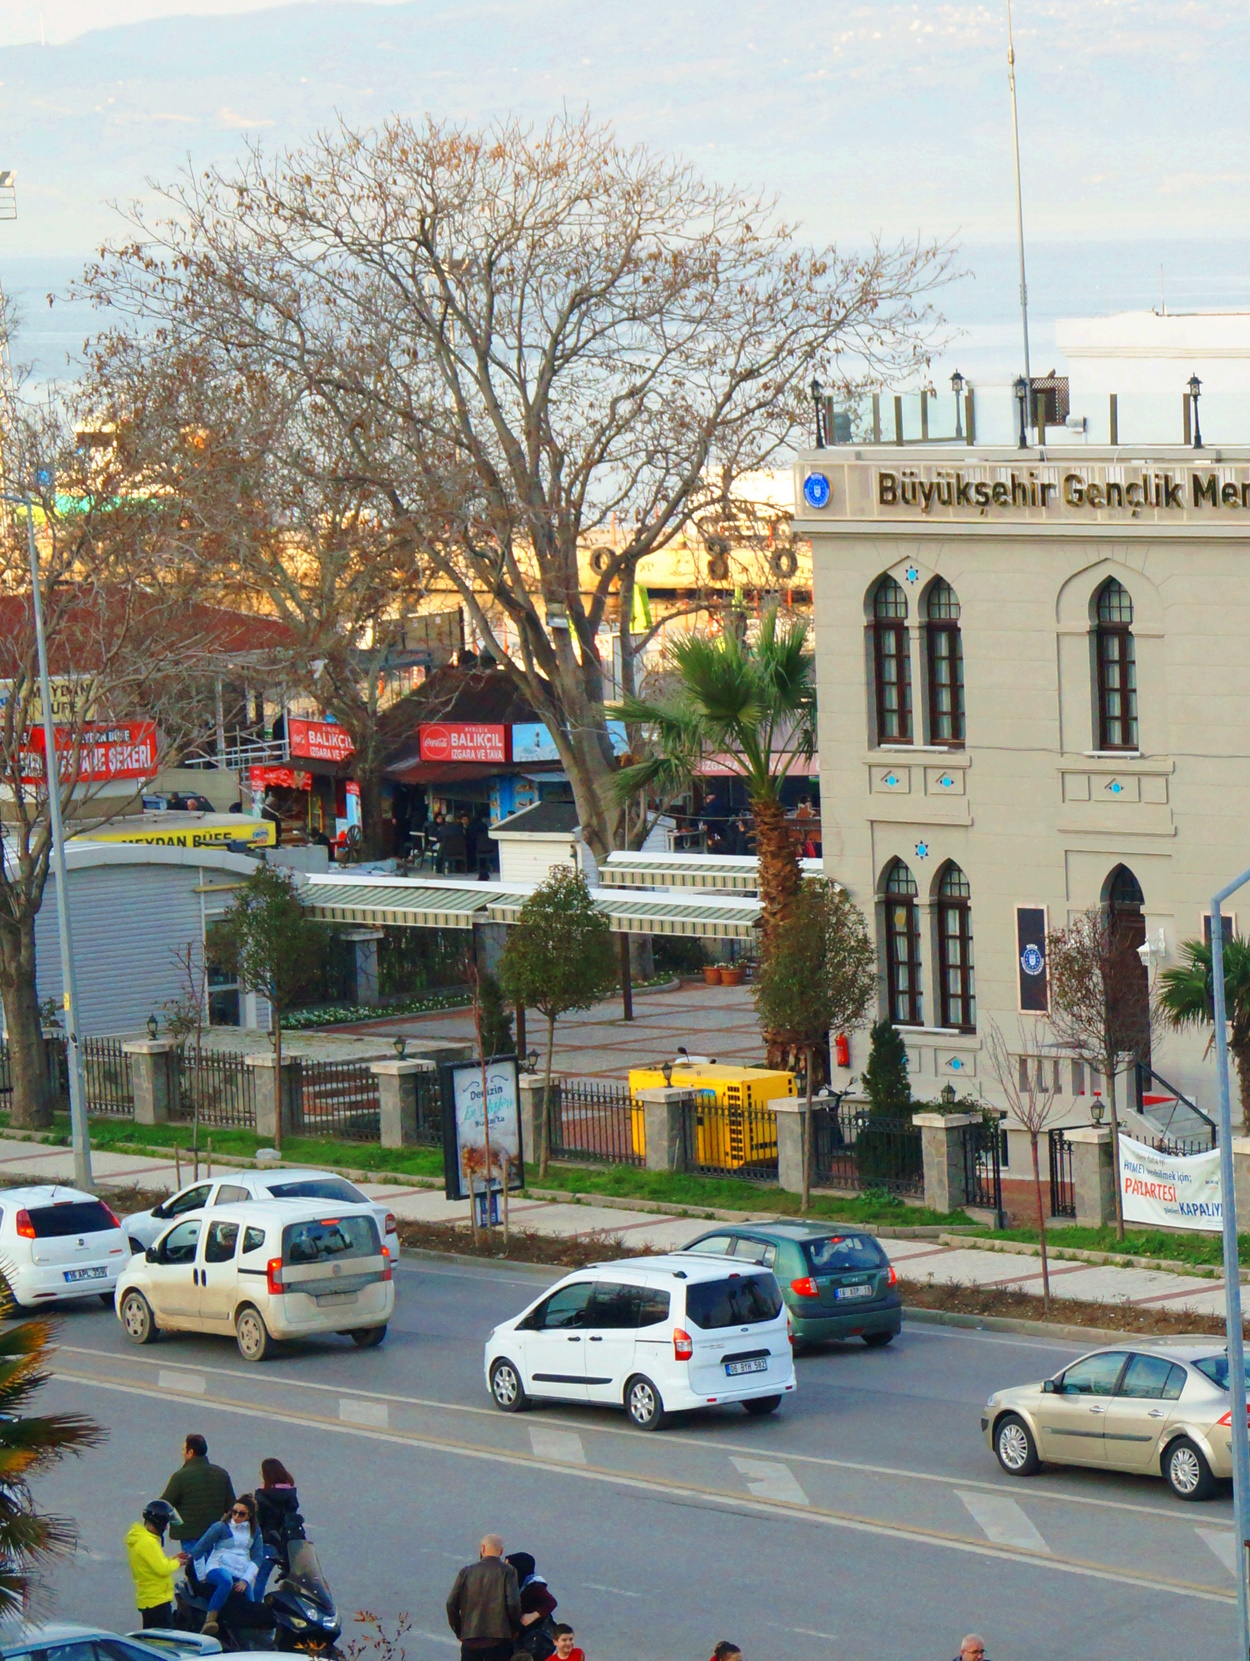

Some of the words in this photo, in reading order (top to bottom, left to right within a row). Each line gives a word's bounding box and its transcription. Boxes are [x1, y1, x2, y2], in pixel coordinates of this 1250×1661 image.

[878, 470, 1057, 517] Büyükşehir
[1063, 471, 1187, 518] Gençlik
[308, 730, 355, 750] BALIKÇIL
[451, 733, 503, 749] BALIKÇIL
[451, 749, 475, 759] IZGARA
[477, 750, 485, 759] VE
[486, 749, 503, 759] TAVA
[1124, 1177, 1177, 1203] PAZARTESİ
[1179, 1202, 1223, 1217] KAPALIYI
